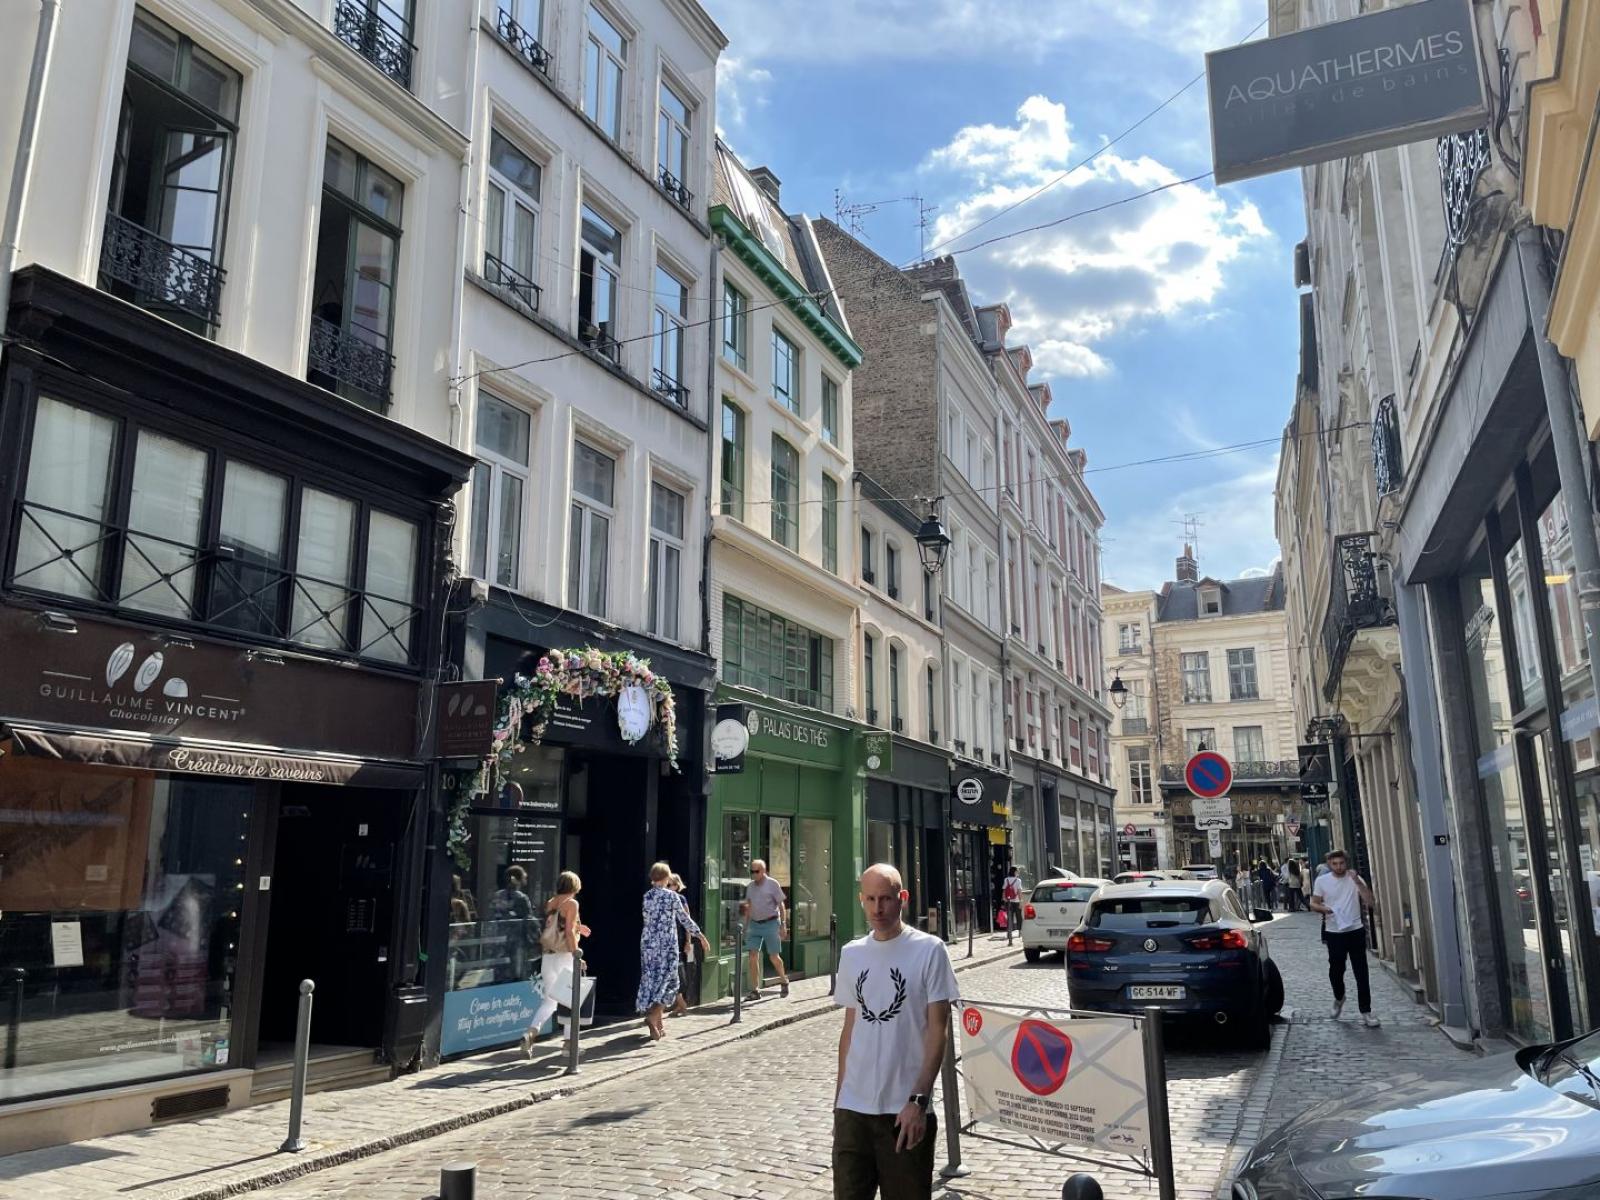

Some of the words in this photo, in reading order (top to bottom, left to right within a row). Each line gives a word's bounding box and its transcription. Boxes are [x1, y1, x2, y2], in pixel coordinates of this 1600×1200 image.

[1223, 30, 1464, 110] AQUATHERMES
[1332, 86, 1366, 104] de
[1383, 62, 1469, 92] bains
[40, 684, 155, 711] GUILLAUME
[109, 708, 180, 726] Chocolatier
[763, 717, 791, 739] PALAIS
[792, 724, 808, 743] DES
[810, 728, 828, 748] THÉS
[169, 749, 245, 775] Créateur
[248, 759, 266, 777] de
[269, 766, 325, 781] saveurs
[442, 773, 456, 790] 10
